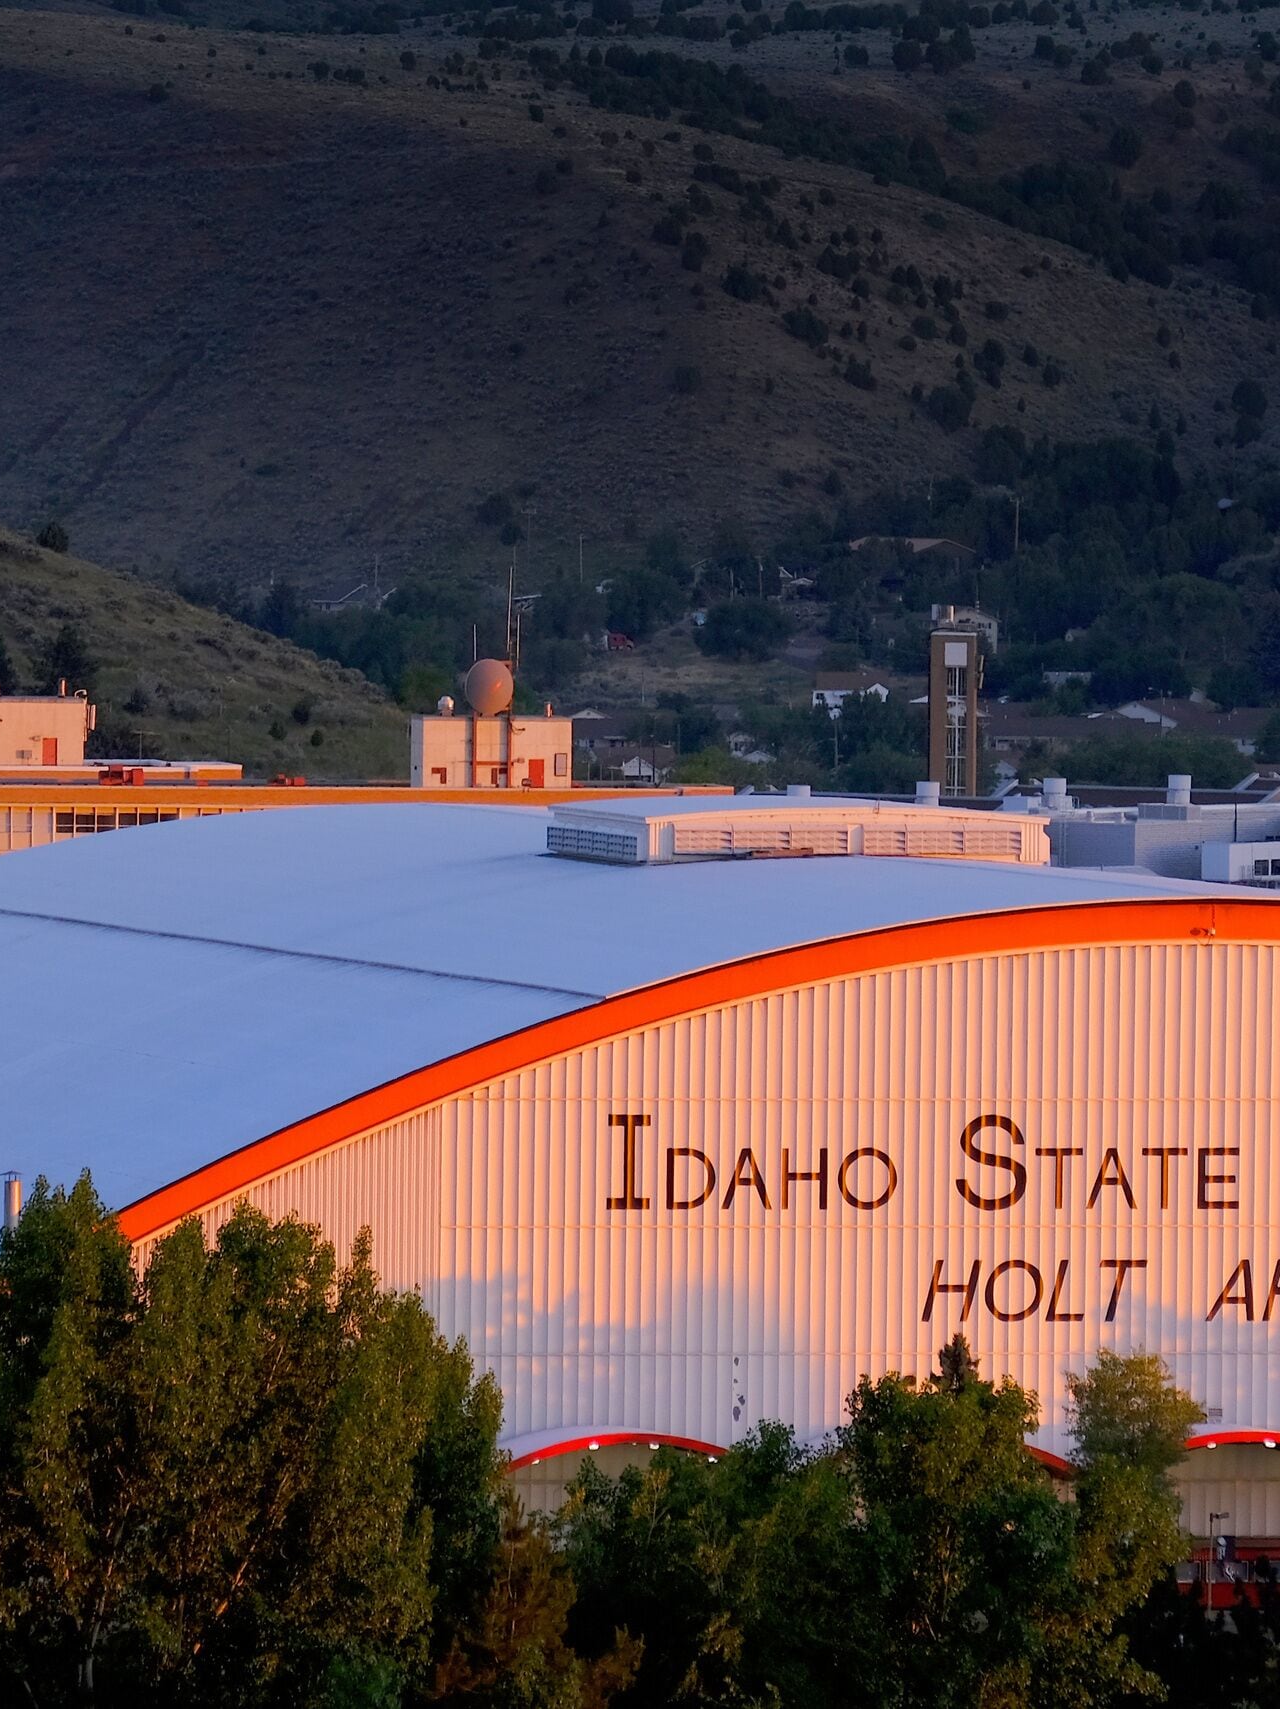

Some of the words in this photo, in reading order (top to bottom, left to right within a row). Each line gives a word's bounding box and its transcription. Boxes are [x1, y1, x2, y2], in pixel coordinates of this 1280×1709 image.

[605, 1113, 899, 1211] IDAHO
[955, 1113, 1240, 1211] STATE
[921, 1258, 1148, 1323] HOLT
